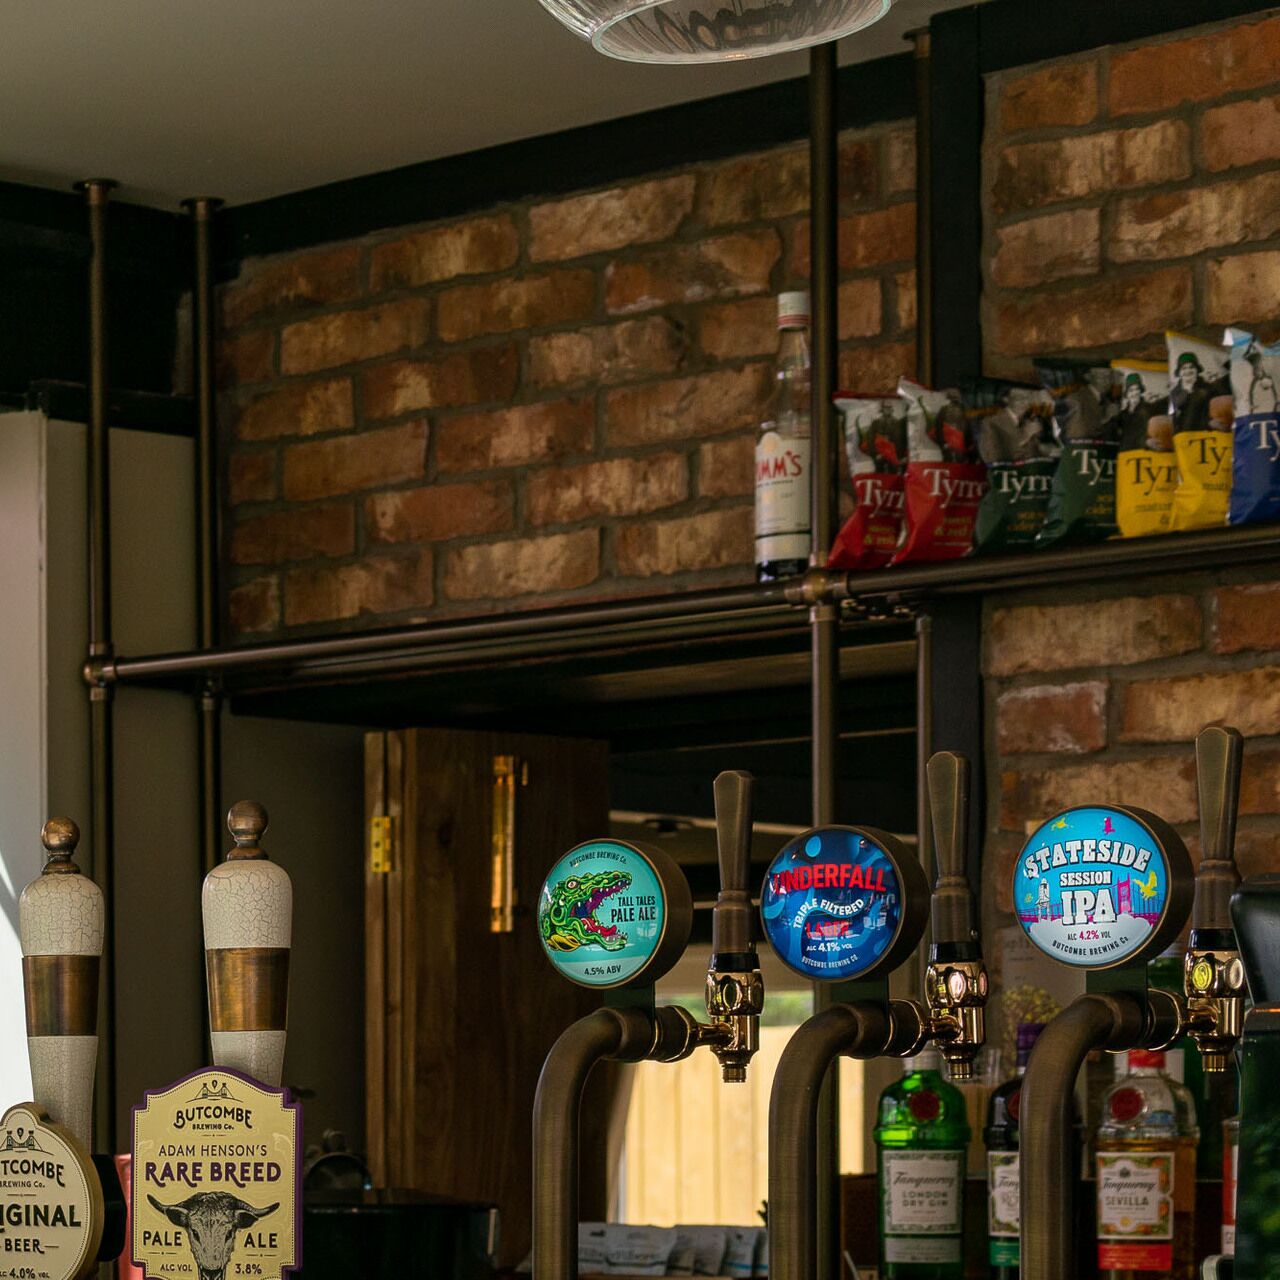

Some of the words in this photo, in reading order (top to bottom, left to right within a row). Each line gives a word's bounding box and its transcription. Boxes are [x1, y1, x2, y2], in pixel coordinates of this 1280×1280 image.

[757, 450, 802, 481] IMM'S
[994, 470, 1053, 504] Tyrr
[569, 851, 595, 867] BUTCOMBE
[597, 851, 620, 861] BREWING
[1024, 839, 1152, 881] STATESIDE
[772, 863, 887, 896] UNDERFALL
[1060, 870, 1112, 887] SESSION
[617, 896, 634, 907] TALL
[635, 895, 656, 906] TALES
[1061, 888, 1117, 926] IPA
[611, 908, 634, 923] PALE
[638, 906, 656, 921] ALE
[793, 898, 818, 929] TRIPLE
[820, 898, 865, 916] FILTERED
[805, 920, 850, 939] LAGER
[1067, 933, 1077, 941] ALC
[1079, 930, 1099, 940] 4.2%
[1100, 931, 1111, 939] VOL
[1052, 940, 1087, 956] BUTCOMBE
[1089, 941, 1120, 956] BREWING
[584, 965, 604, 976] 4.5%
[606, 965, 622, 974] ABV
[172, 1106, 253, 1129] BUTCOMBE
[192, 1123, 223, 1131] BREWING
[158, 1144, 196, 1156] ADAM
[201, 1144, 268, 1157] HENSON'S
[145, 1161, 203, 1188] RARE
[210, 1161, 282, 1188] BREED
[1105, 1196, 1150, 1206] SEVILLA
[4, 1238, 45, 1254] BEER
[142, 1231, 182, 1247] PALE
[244, 1232, 278, 1249] ALE
[9, 1267, 36, 1279] 4.0%
[160, 1263, 176, 1272] ALC
[177, 1263, 193, 1272] VOL
[235, 1263, 263, 1275] 3.8%
